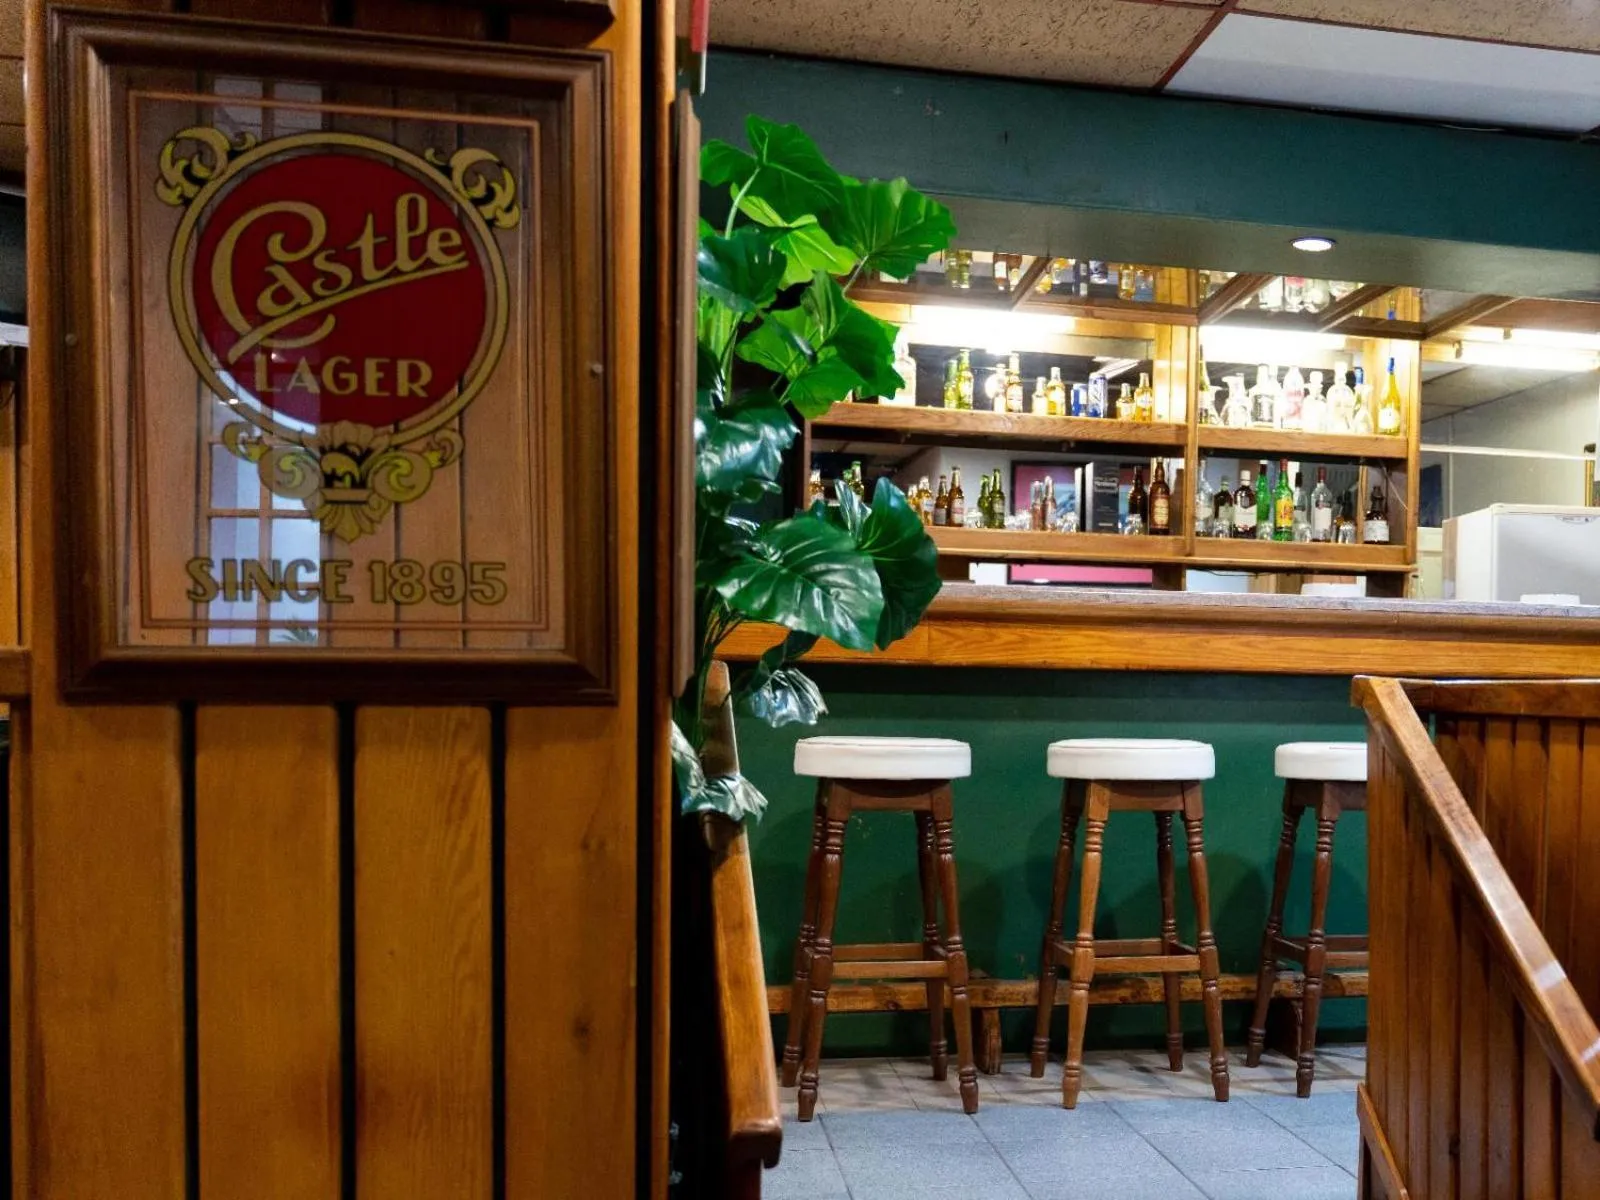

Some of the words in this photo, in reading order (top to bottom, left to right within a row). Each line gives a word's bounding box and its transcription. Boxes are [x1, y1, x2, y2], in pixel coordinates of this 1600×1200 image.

[211, 192, 470, 365] Castle
[254, 352, 433, 398] LAGER
[185, 556, 355, 604] SINCE
[367, 559, 508, 606] 1895
